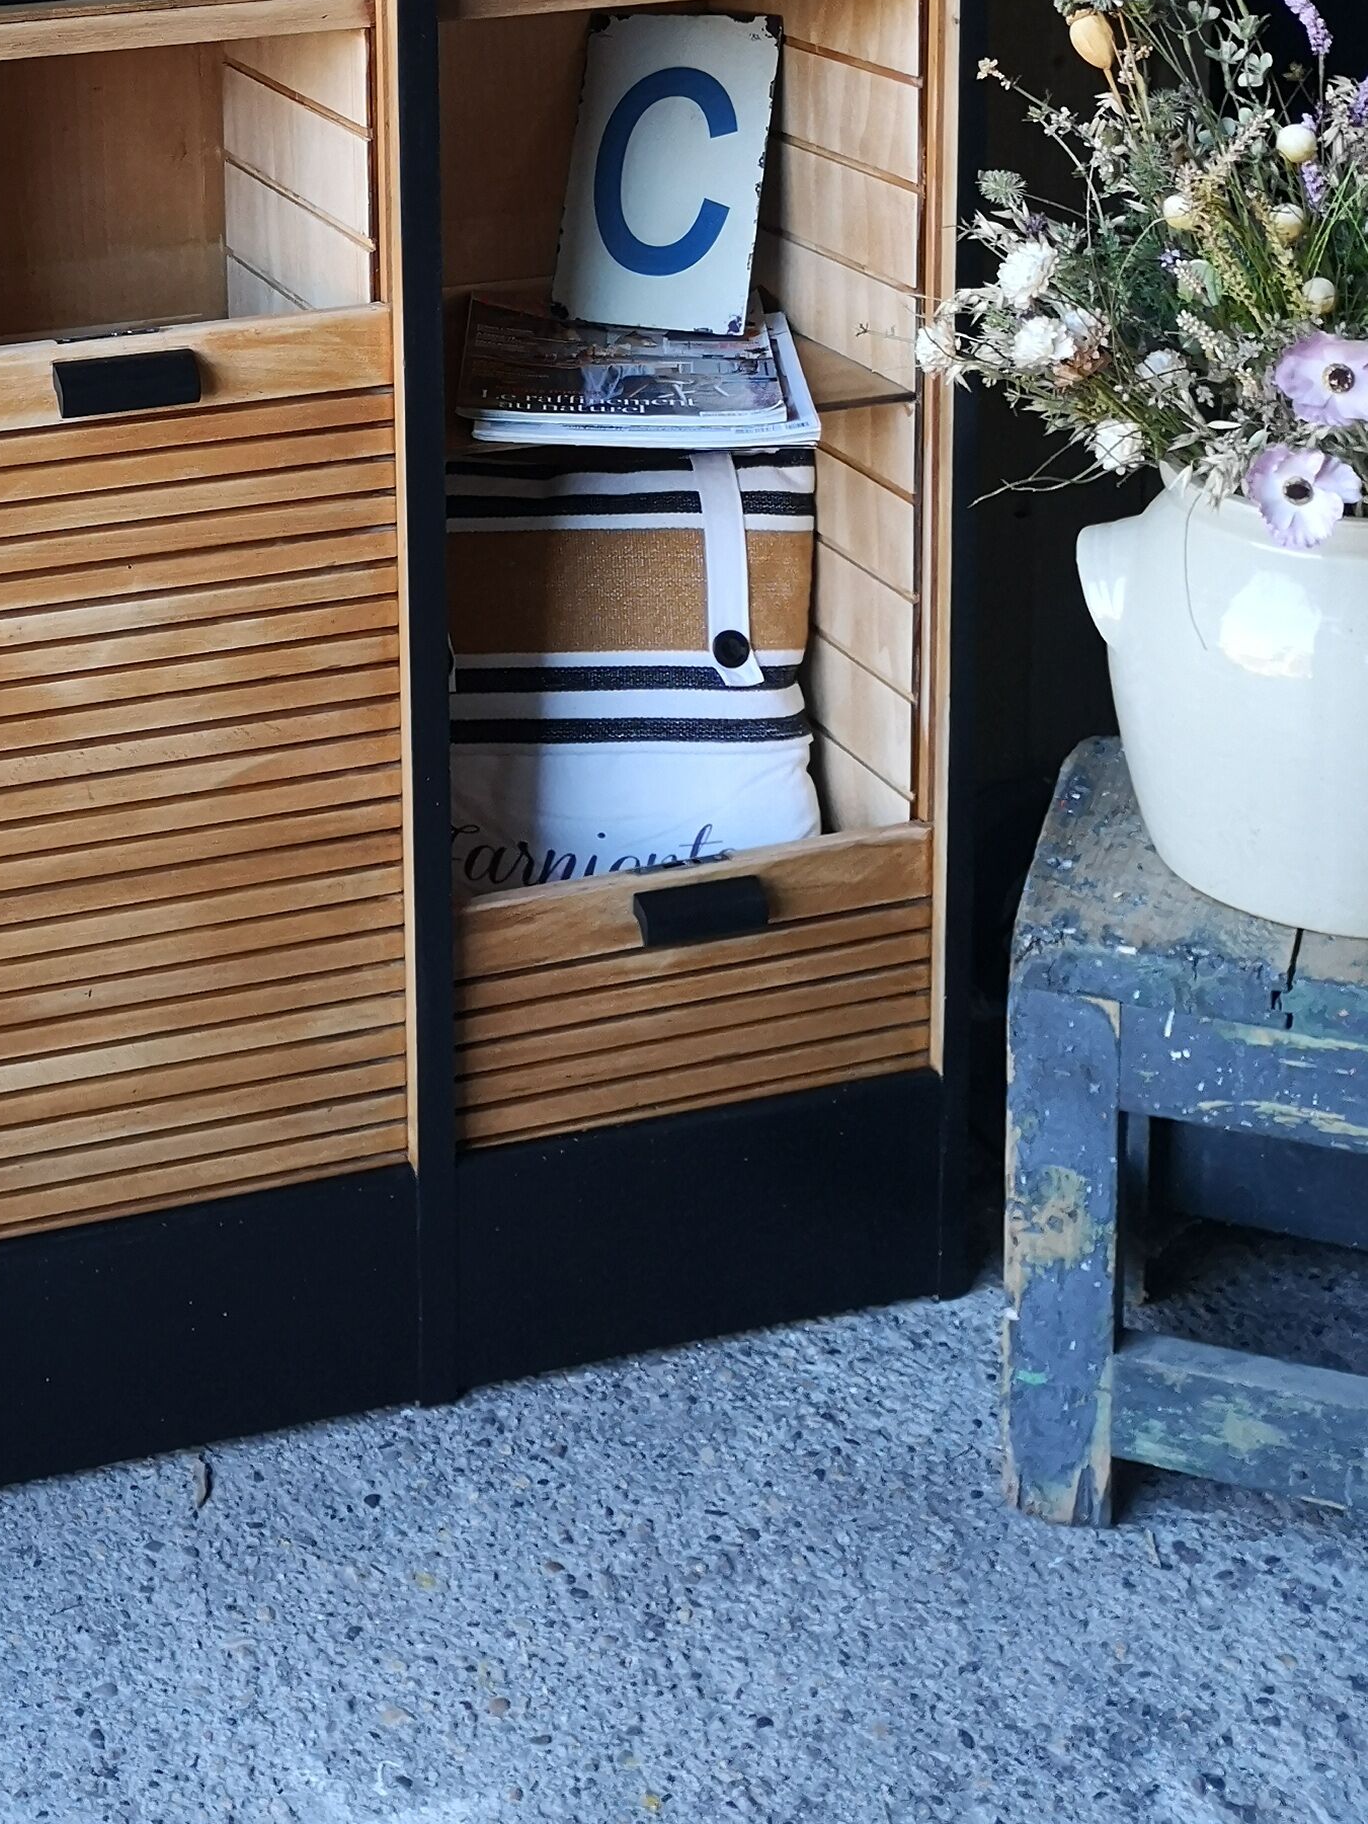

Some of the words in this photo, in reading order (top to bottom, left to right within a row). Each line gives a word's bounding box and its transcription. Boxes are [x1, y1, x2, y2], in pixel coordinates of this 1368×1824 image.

[593, 66, 738, 277] C
[498, 400, 532, 410] au
[542, 402, 647, 414] naturel
[525, 392, 698, 408] raffinement
